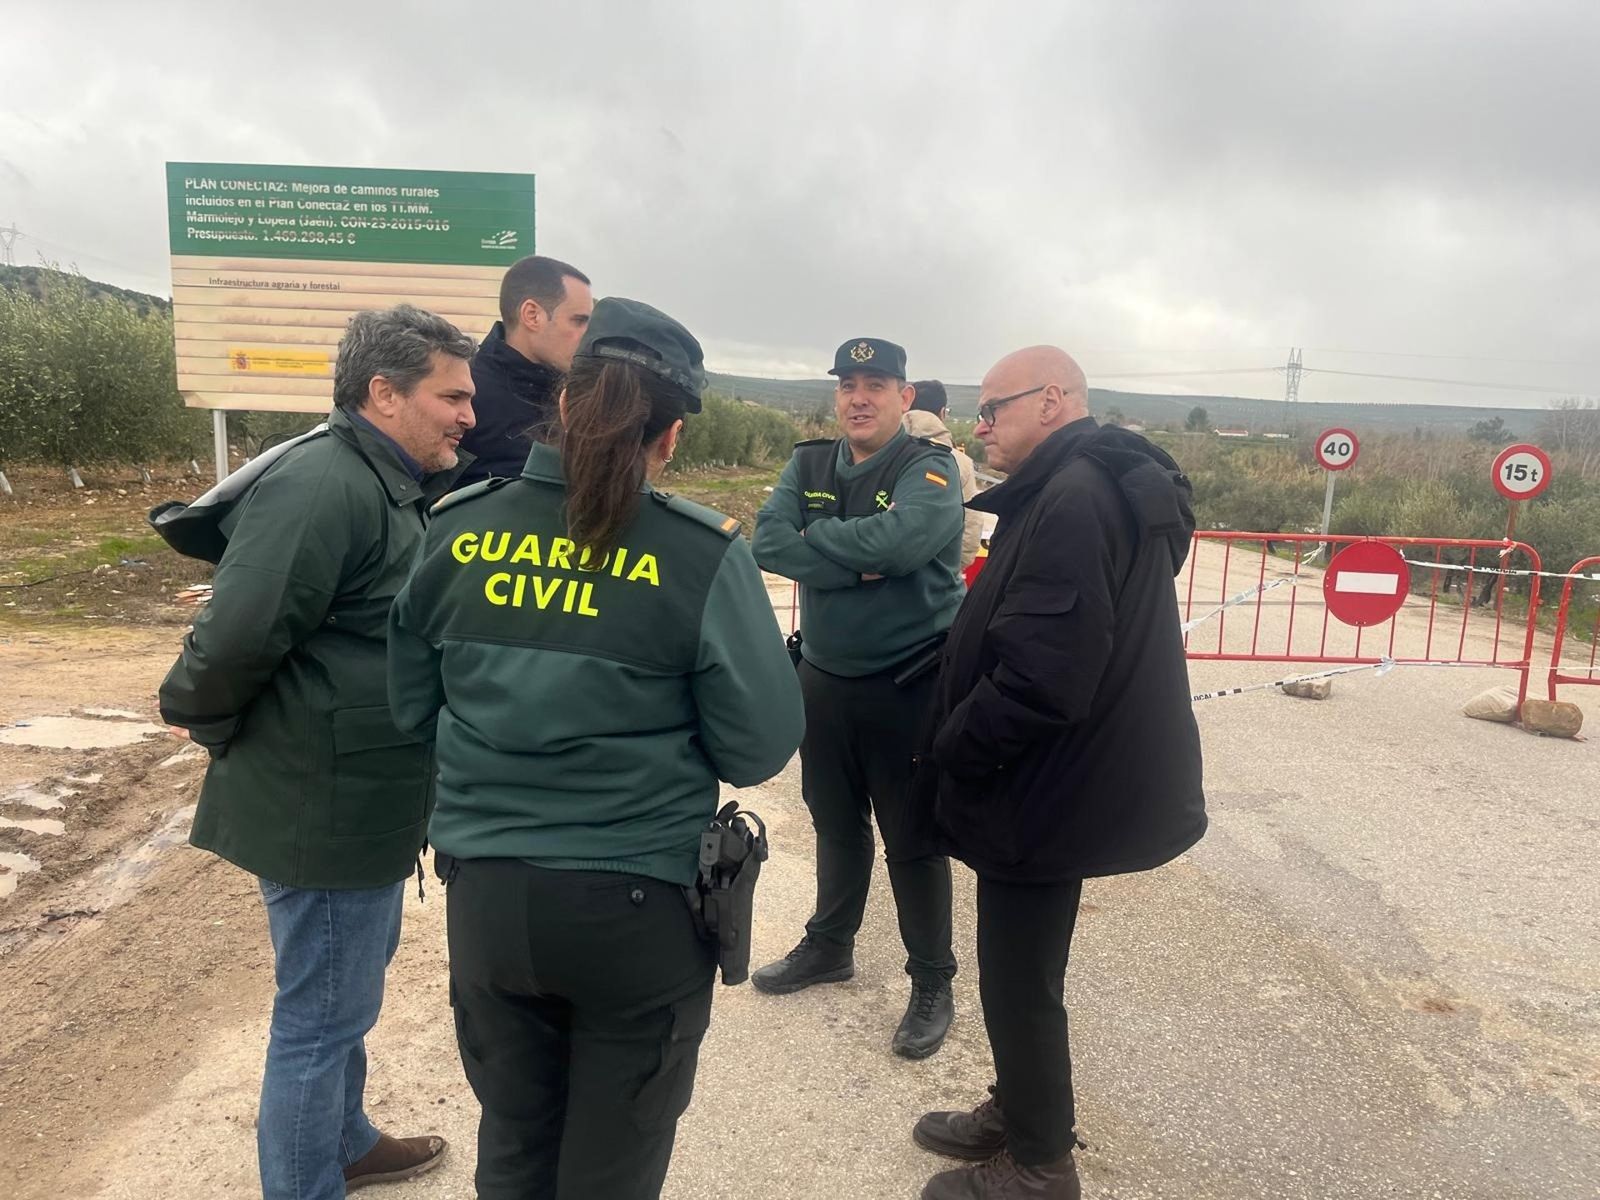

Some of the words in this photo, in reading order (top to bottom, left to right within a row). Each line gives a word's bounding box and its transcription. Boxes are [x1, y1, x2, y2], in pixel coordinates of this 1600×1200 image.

[184, 177, 217, 190] PLAN
[220, 179, 288, 192] CONECTA2:
[292, 182, 331, 196] Mejora
[333, 183, 348, 194] de
[351, 185, 398, 196] caminos
[401, 187, 440, 198] rurales
[185, 194, 234, 206] incluidos
[237, 198, 252, 207] en
[255, 198, 265, 208] el
[268, 197, 294, 209] Plan
[297, 198, 350, 211] Conecta2
[353, 202, 368, 212] en
[371, 201, 387, 213] los
[186, 210, 244, 226] Marmolejo
[247, 216, 254, 226] y
[257, 213, 296, 227] Lopera
[208, 277, 269, 288] Infraestructura
[271, 280, 300, 290] agraria
[302, 281, 307, 290] y
[309, 280, 340, 291] forestal
[1323, 441, 1350, 456] 40
[484, 572, 599, 617] CIVIL
